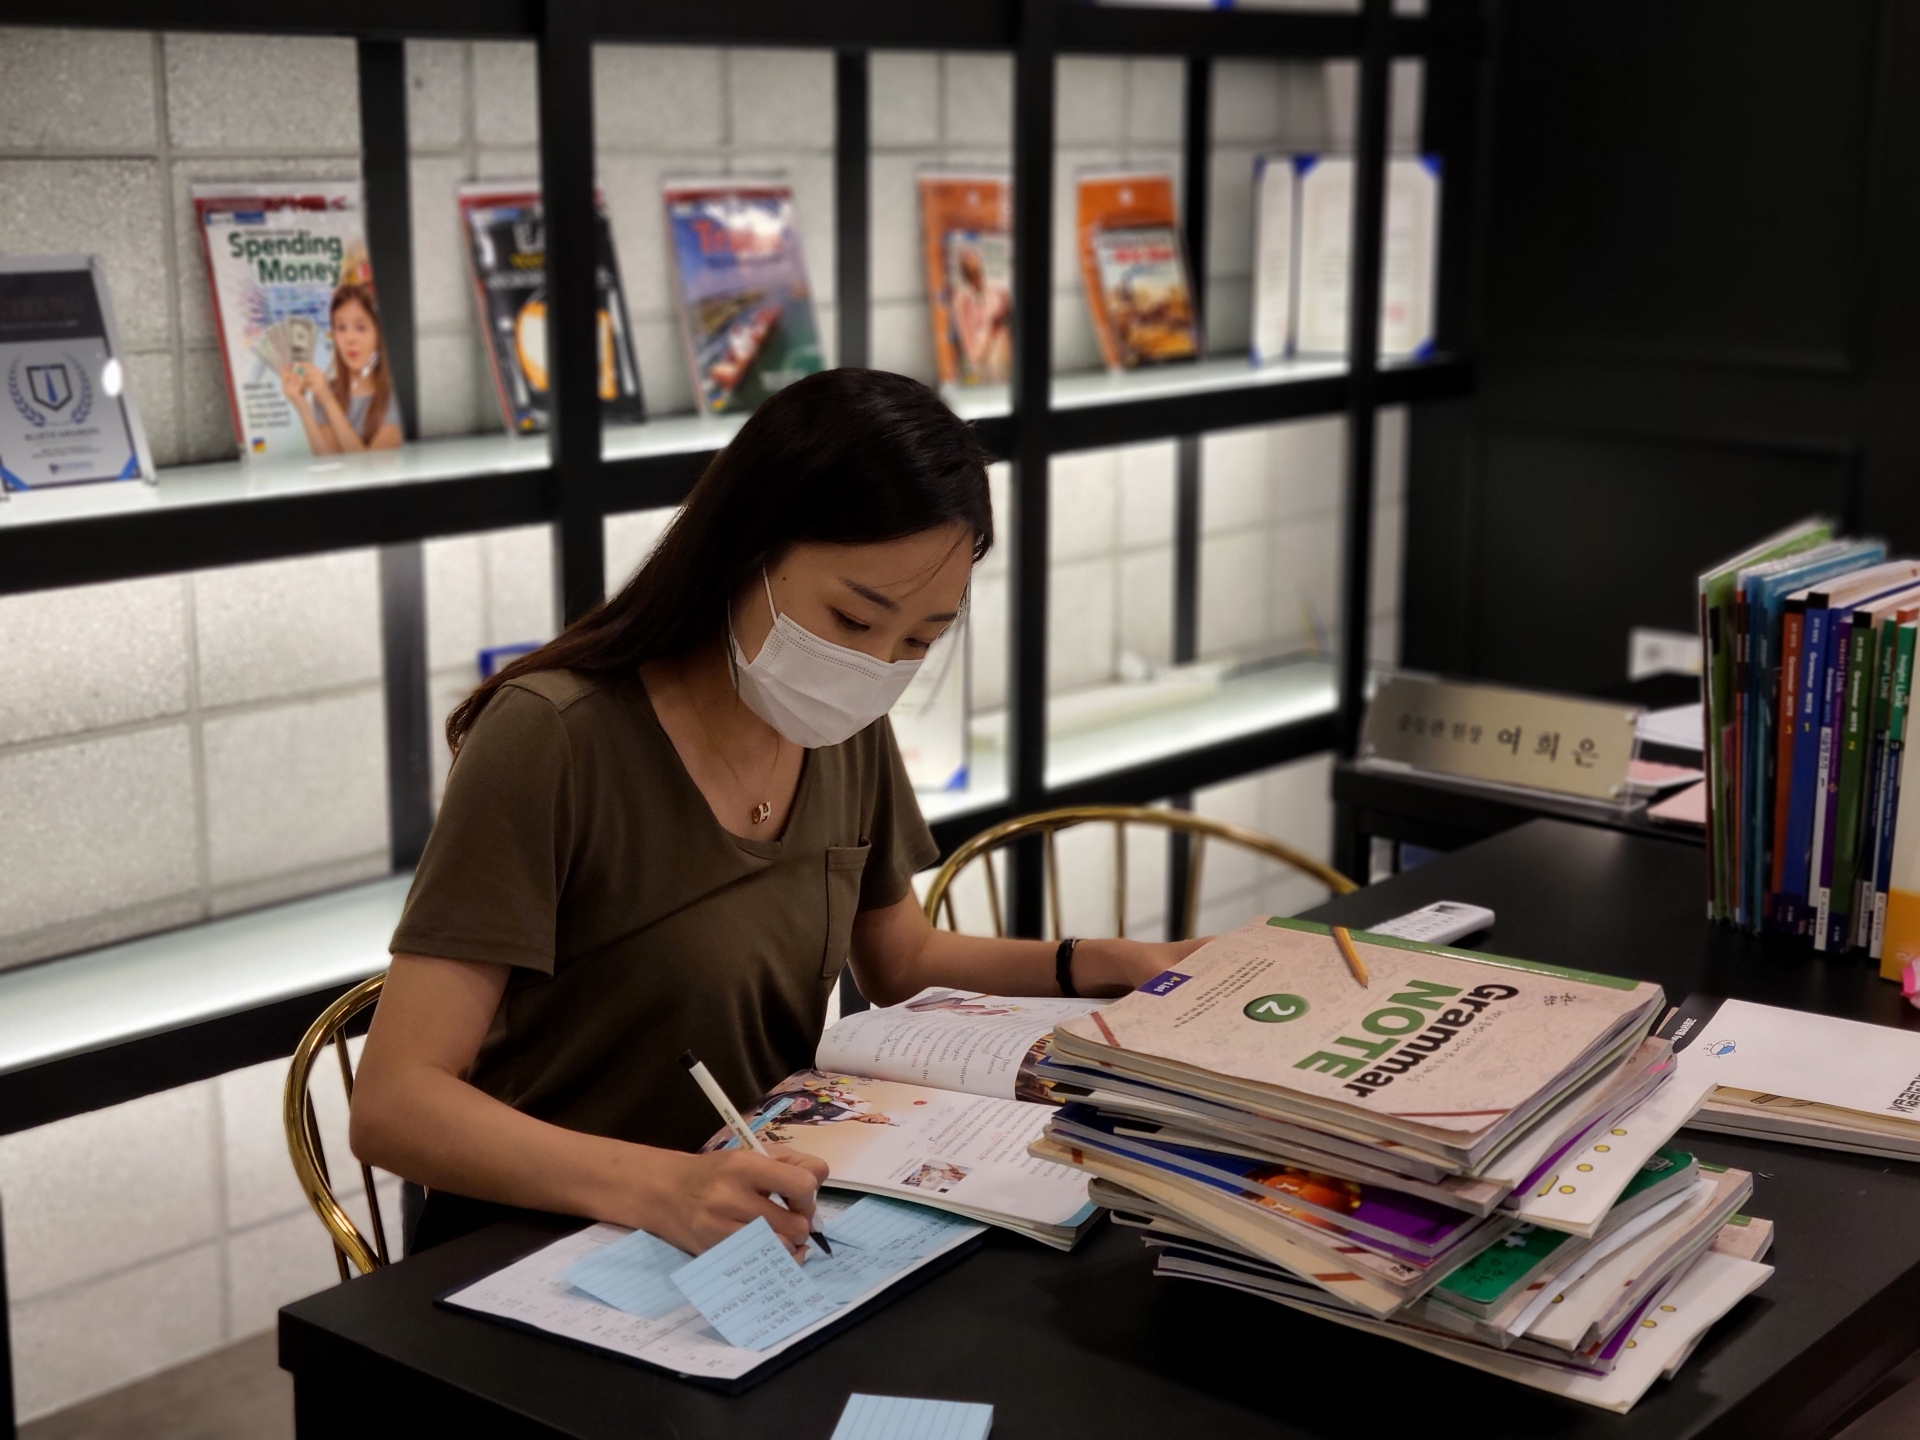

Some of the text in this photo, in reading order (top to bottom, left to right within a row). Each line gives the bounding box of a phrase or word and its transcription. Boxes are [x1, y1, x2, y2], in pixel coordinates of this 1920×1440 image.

[228, 228, 343, 263] Spending
[257, 257, 342, 288] Money
[1807, 652, 1818, 689] Grammar
[1836, 671, 1846, 693] Link
[1897, 654, 1908, 682] Insight
[1825, 668, 1834, 702] Grammar
[1852, 670, 1861, 708] Grammar
[1895, 685, 1906, 708] Link
[1805, 692, 1813, 714] NOTE
[1850, 711, 1858, 733] NOTE
[1256, 1000, 1297, 1017] 2
[1292, 980, 1464, 1080] NOTE
[1342, 983, 1519, 1099] Grammar
